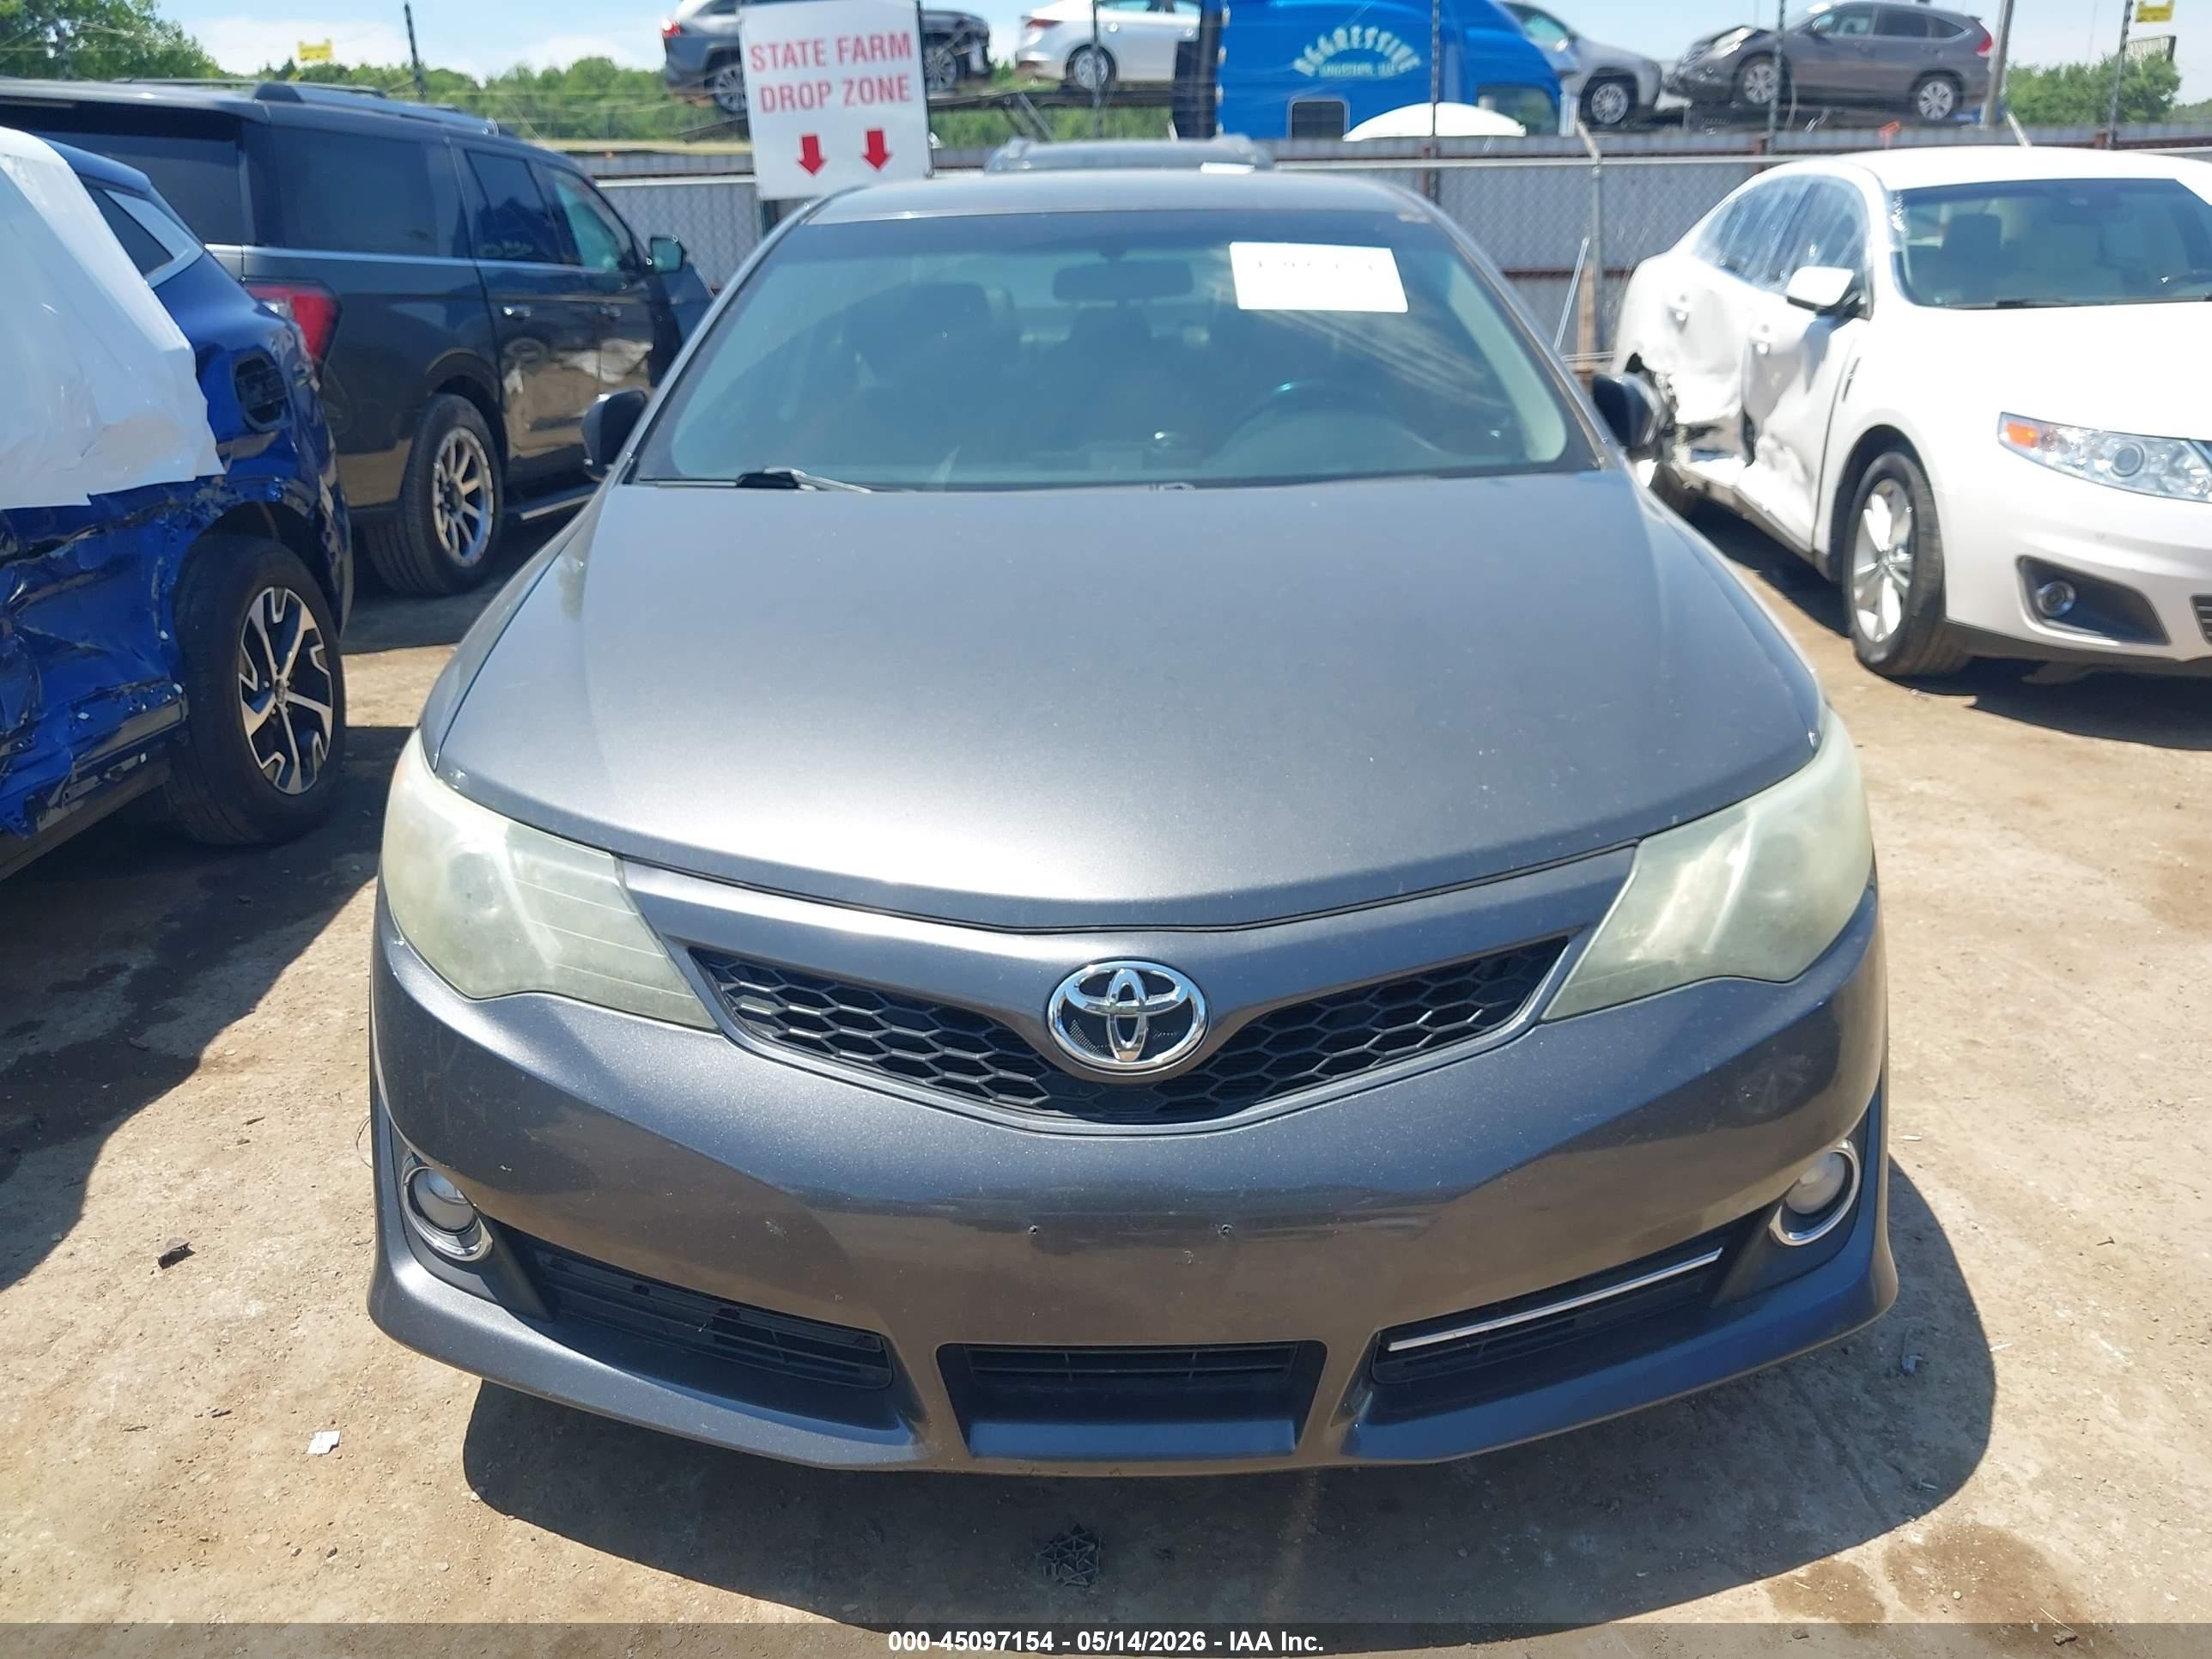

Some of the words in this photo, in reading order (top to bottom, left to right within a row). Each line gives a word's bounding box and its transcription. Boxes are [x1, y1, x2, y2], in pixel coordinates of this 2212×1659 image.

[751, 36, 828, 72] STATE
[836, 32, 912, 64] FARM
[760, 79, 831, 113] DROP
[842, 74, 912, 106] ZONE
